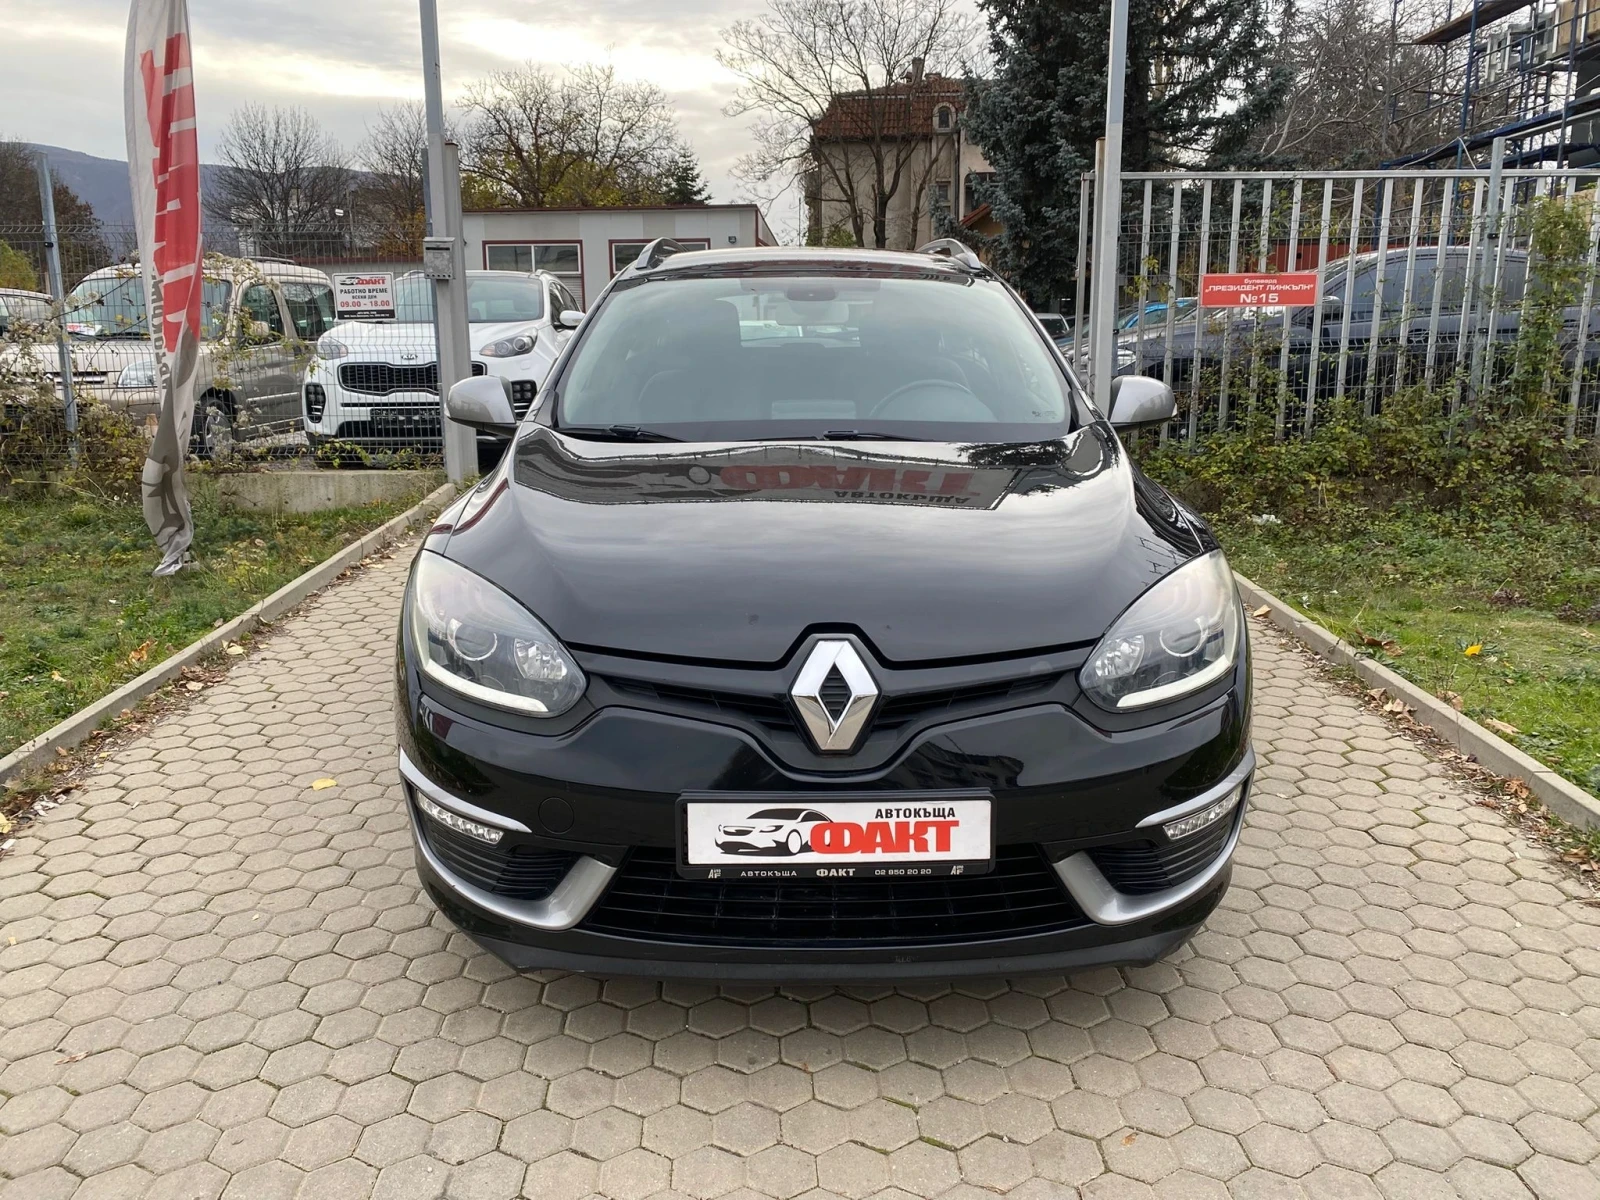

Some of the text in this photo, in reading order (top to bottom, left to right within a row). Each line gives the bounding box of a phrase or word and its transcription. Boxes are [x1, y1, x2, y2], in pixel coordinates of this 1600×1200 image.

[875, 807, 956, 819] АВТОКЪЩА
[810, 820, 959, 854] ФАКТ
[816, 868, 856, 877] ФАКТ
